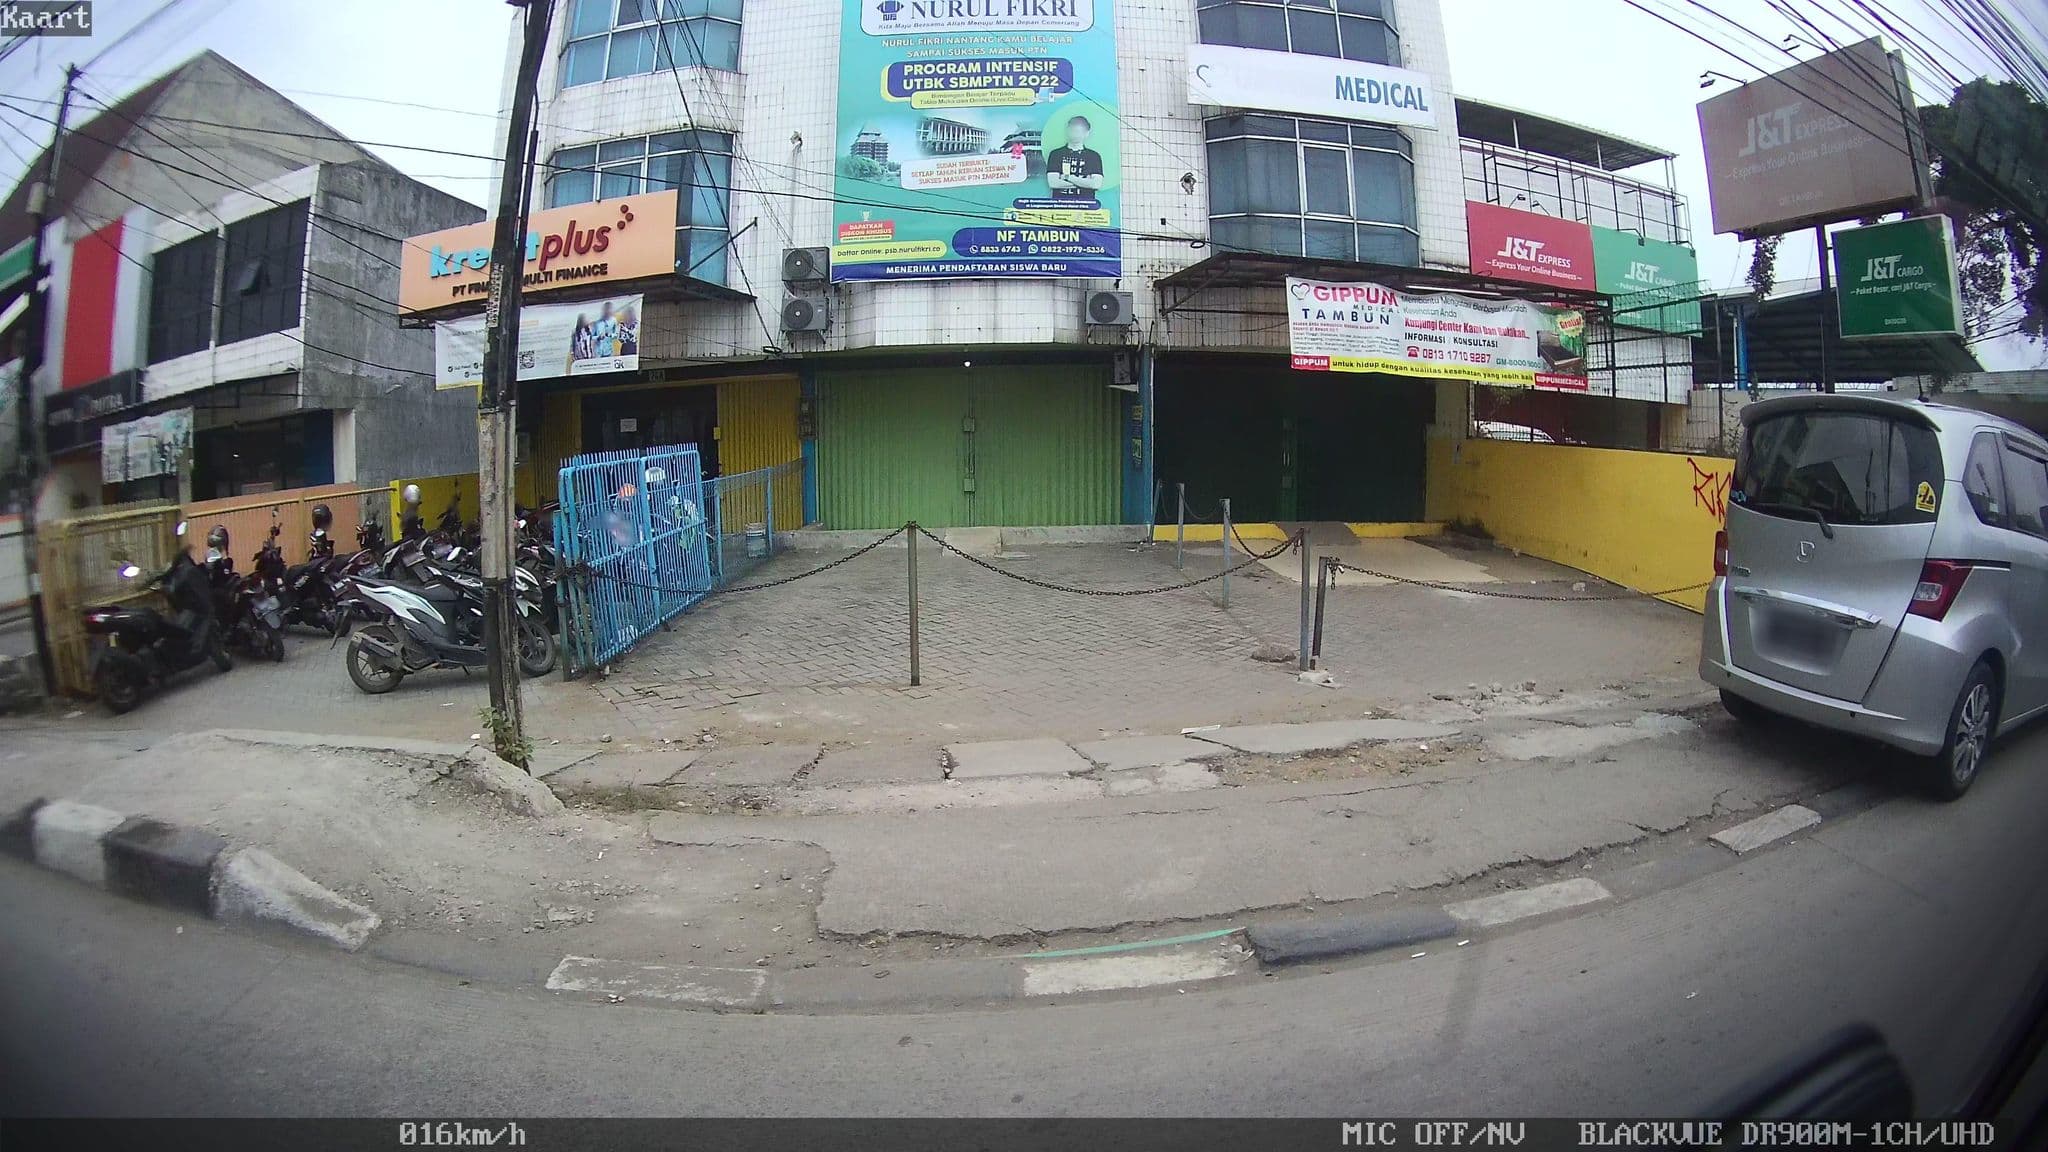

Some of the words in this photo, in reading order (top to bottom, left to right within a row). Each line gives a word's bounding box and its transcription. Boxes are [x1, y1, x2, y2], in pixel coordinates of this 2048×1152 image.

[912, 0, 999, 19] NURUL
[1007, 0, 1079, 18] FIKRI
[882, 38, 914, 47] NURUL
[918, 37, 943, 46] FIKRI
[946, 35, 994, 45] NANTANG
[998, 34, 1027, 44] KAMU
[1030, 35, 1073, 45] BELAJAR
[907, 49, 944, 58] SAMPAI
[948, 47, 986, 57] SUKSES
[989, 46, 1025, 56] MASUK
[903, 62, 981, 76] PROGRAM
[986, 61, 1058, 73] INTENSIF
[903, 77, 945, 90] UTBK
[949, 75, 1014, 88] SBMPTN
[1019, 74, 1059, 86] 2022
[1335, 75, 1429, 112] MEDICAL
[1738, 102, 1802, 157] J&T
[997, 230, 1016, 242] NF
[1020, 230, 1080, 242] TAMBUN
[429, 219, 612, 279] kretplus
[837, 249, 859, 257] Daftar
[1497, 236, 1545, 262] J&T
[1537, 253, 1571, 269] EXPRESS
[886, 265, 937, 274] MENERIMA
[939, 263, 1007, 273] PENDAFTARAN
[1009, 263, 1039, 272] SISWA
[1041, 263, 1067, 271] BARU
[1491, 258, 1516, 270] Express
[1516, 261, 1531, 272] Your
[1531, 265, 1552, 276] Online
[1551, 268, 1577, 281] Business
[1624, 261, 1660, 284] J&T
[1860, 254, 1903, 282] J&T
[1896, 265, 1924, 278] CARGO
[452, 285, 466, 297] PT
[556, 262, 608, 281] FINANCE
[1313, 285, 1399, 307] GIPPUM
[1301, 308, 1391, 325] TAMBUN
[1352, 303, 1400, 314] MEDICAL
[1404, 317, 1438, 331] Kunjungi
[1438, 320, 1463, 333] Center
[1404, 332, 1446, 344] INFORMASI
[1453, 337, 1499, 348] KONSULTASI
[1422, 348, 1444, 360] 0813
[1447, 349, 1469, 361] 1710
[1469, 351, 1491, 364] 9287
[1294, 357, 1329, 367] GIPPUM
[1332, 360, 1355, 368] untuk
[1356, 359, 1380, 369] hidup
[1381, 363, 1409, 372] dengan
[1410, 366, 1442, 374] kualitas
[1443, 369, 1482, 377] kesehatan
[1483, 372, 1500, 380] yang
